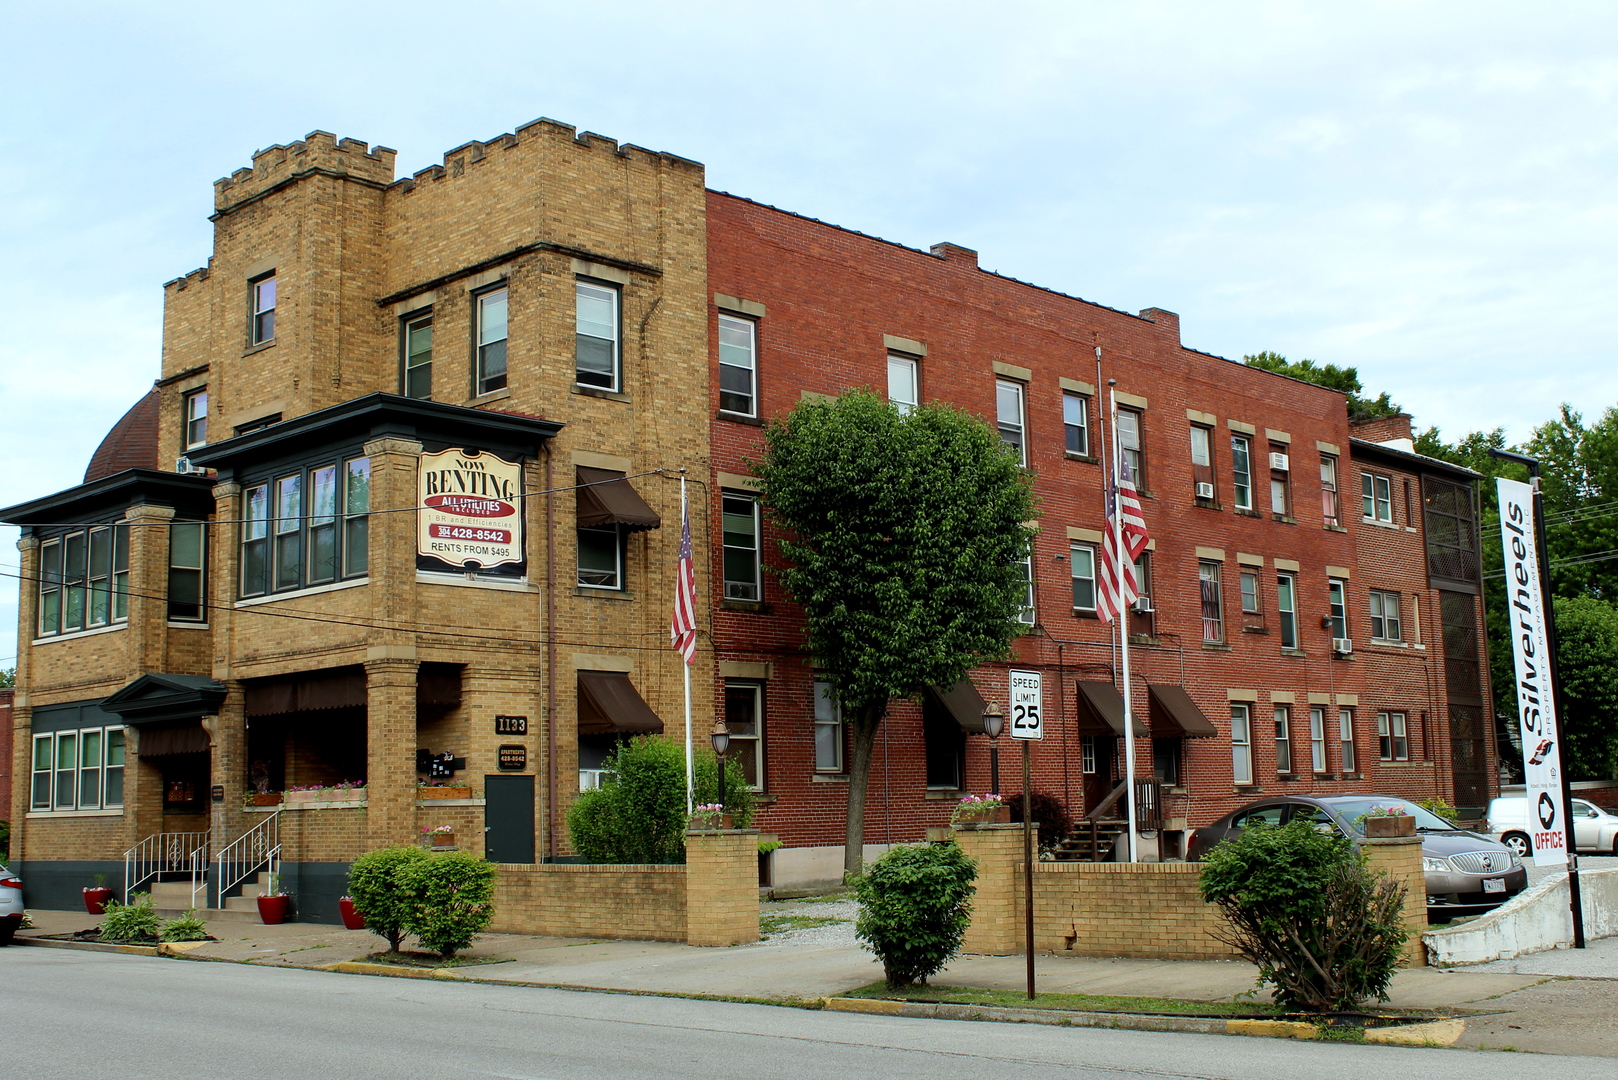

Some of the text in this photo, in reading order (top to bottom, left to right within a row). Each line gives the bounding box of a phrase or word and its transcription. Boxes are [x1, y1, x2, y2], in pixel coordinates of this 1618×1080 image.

[455, 459, 487, 471] NOW
[425, 469, 515, 503] RENTING
[441, 496, 501, 512] ALL UTILITIES
[451, 506, 491, 515] INCLUDED
[467, 518, 513, 529] Efficiencies
[438, 526, 504, 542] 304 428-8542
[431, 542, 510, 557] RENTS FROM $495
[1505, 501, 1542, 737] Silverheels
[1012, 677, 1039, 689] SPEED
[1015, 692, 1036, 703] LIMIT
[1539, 653, 1553, 736] PROPERTY
[499, 718, 526, 731] 1133
[1013, 704, 1040, 730] 25
[1534, 831, 1564, 851] OFFICE
